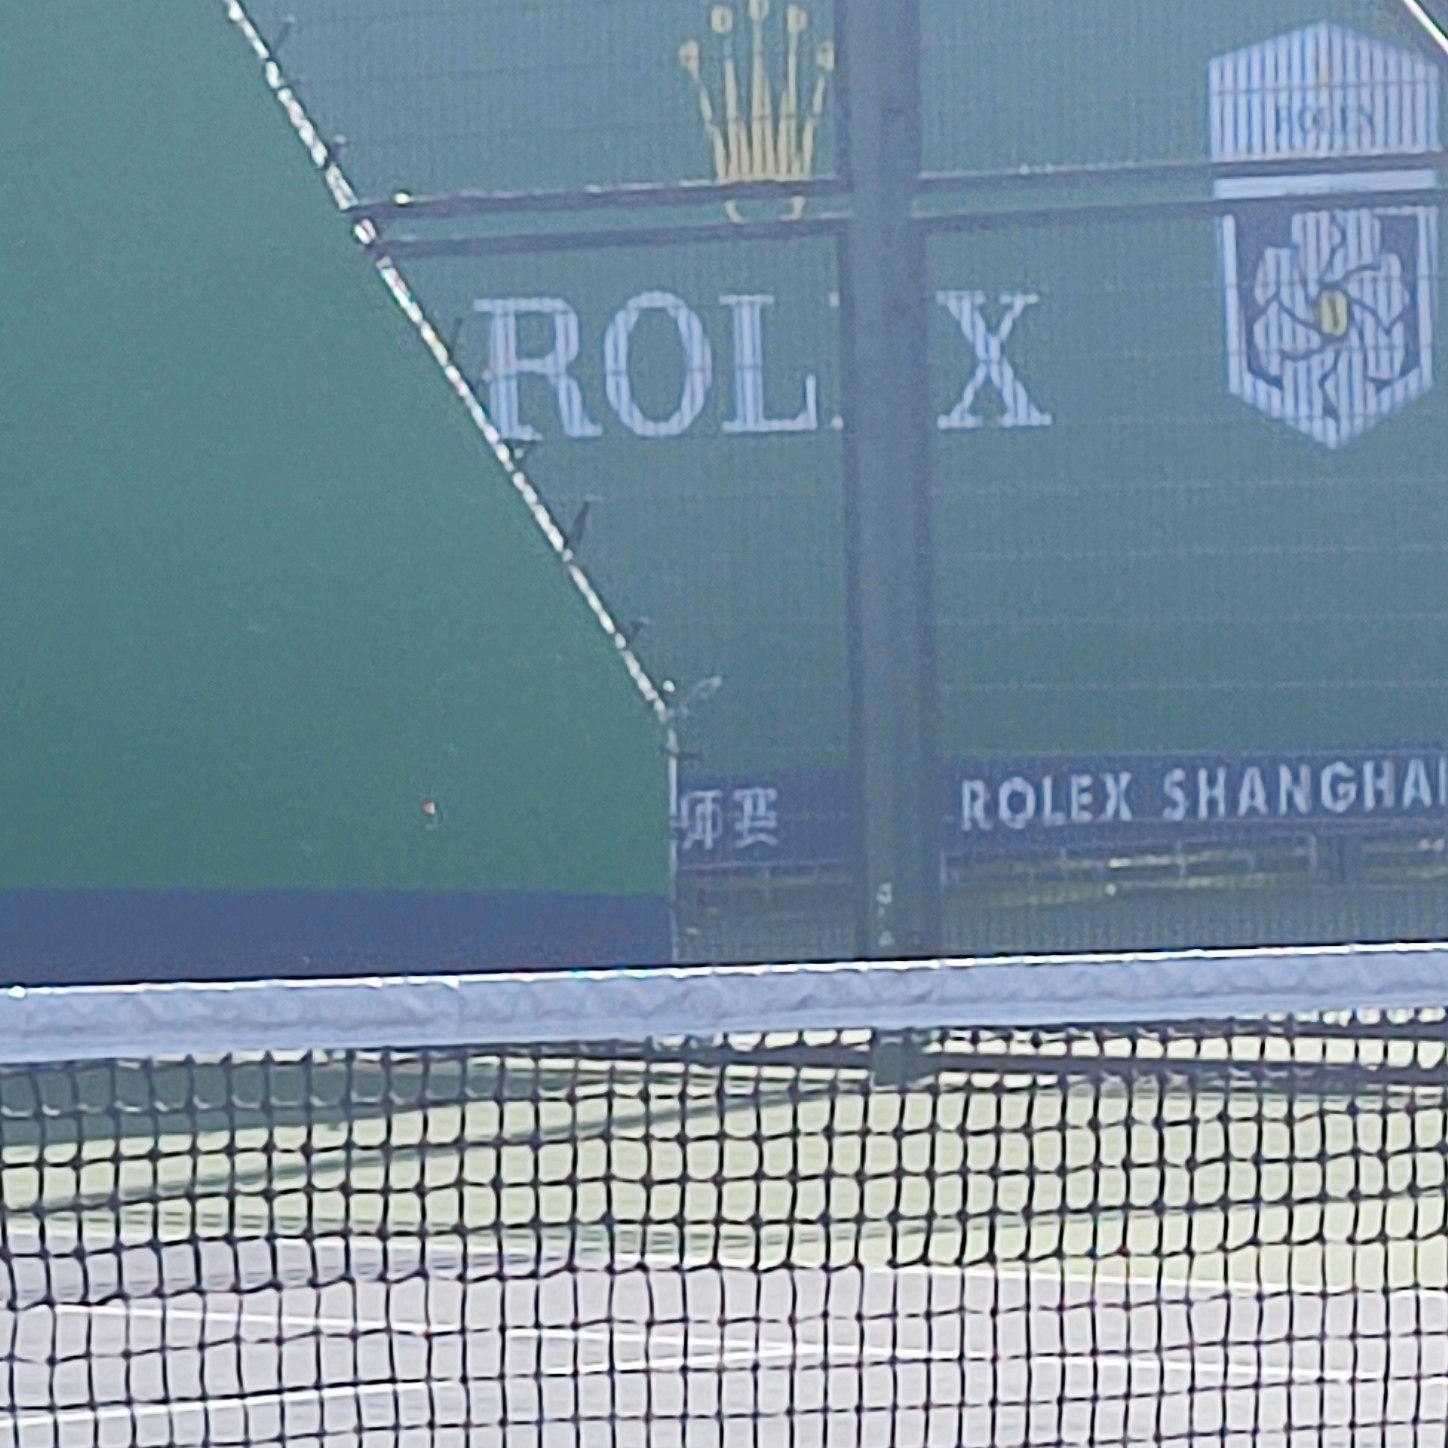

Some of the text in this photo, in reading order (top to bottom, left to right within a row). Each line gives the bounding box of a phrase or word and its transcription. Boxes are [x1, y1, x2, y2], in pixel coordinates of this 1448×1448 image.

[474, 290, 1052, 440] ROLX
[961, 771, 1133, 832] ROLEX
[1162, 755, 1448, 821] SHANGHAI
